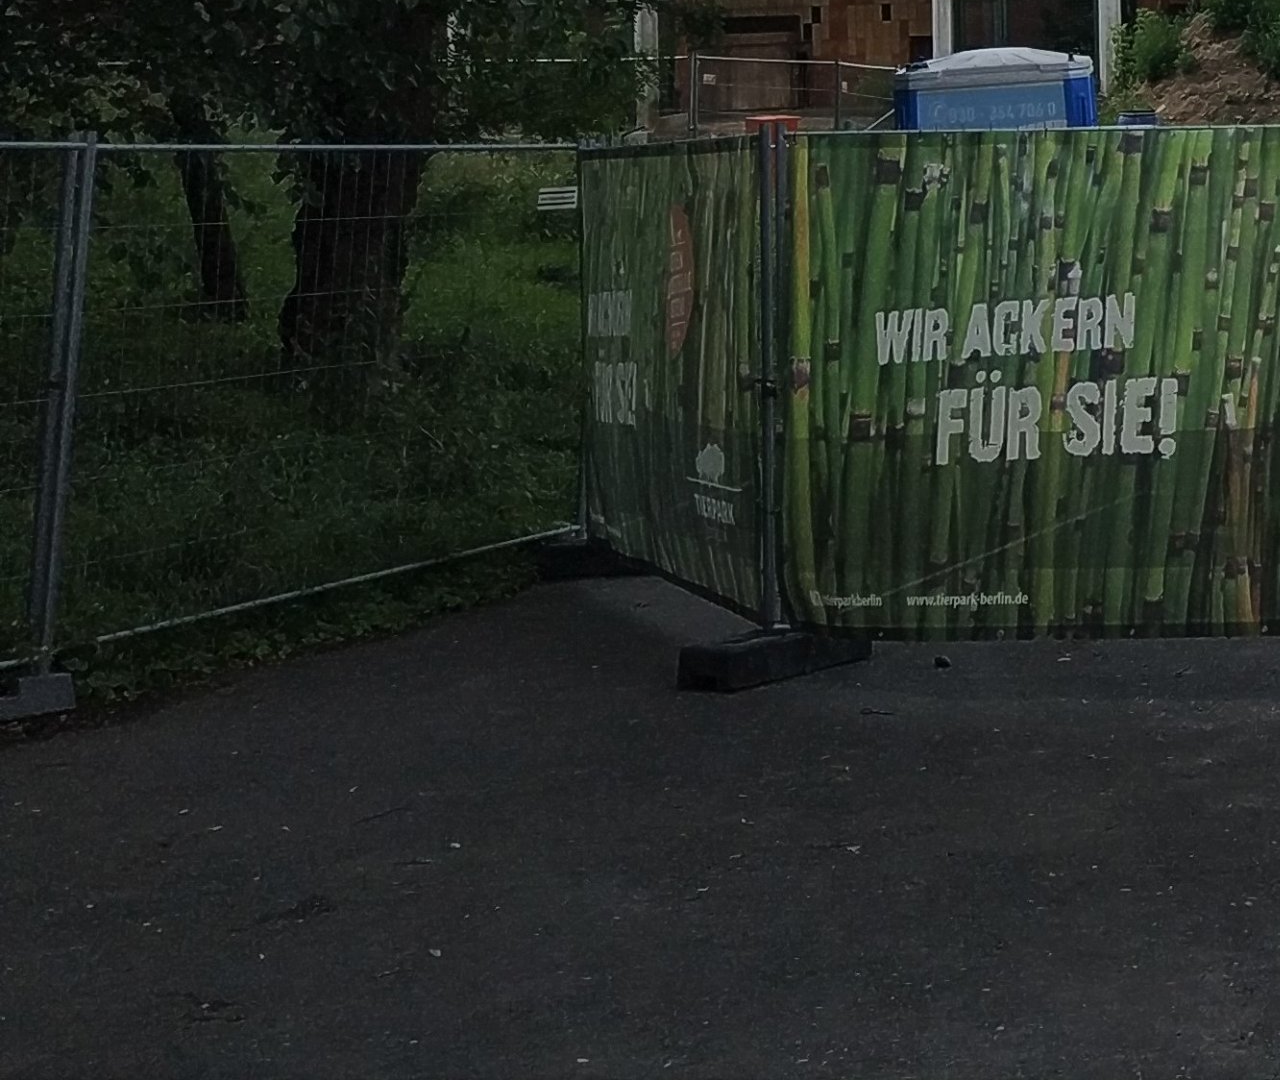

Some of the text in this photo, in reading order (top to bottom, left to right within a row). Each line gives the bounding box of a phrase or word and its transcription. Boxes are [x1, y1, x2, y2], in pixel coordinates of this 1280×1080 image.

[875, 291, 1136, 365] WIR ACKERN
[935, 370, 1180, 466] FÜR SIE!
[906, 591, 1029, 610] www.tierpark-berlin.de
